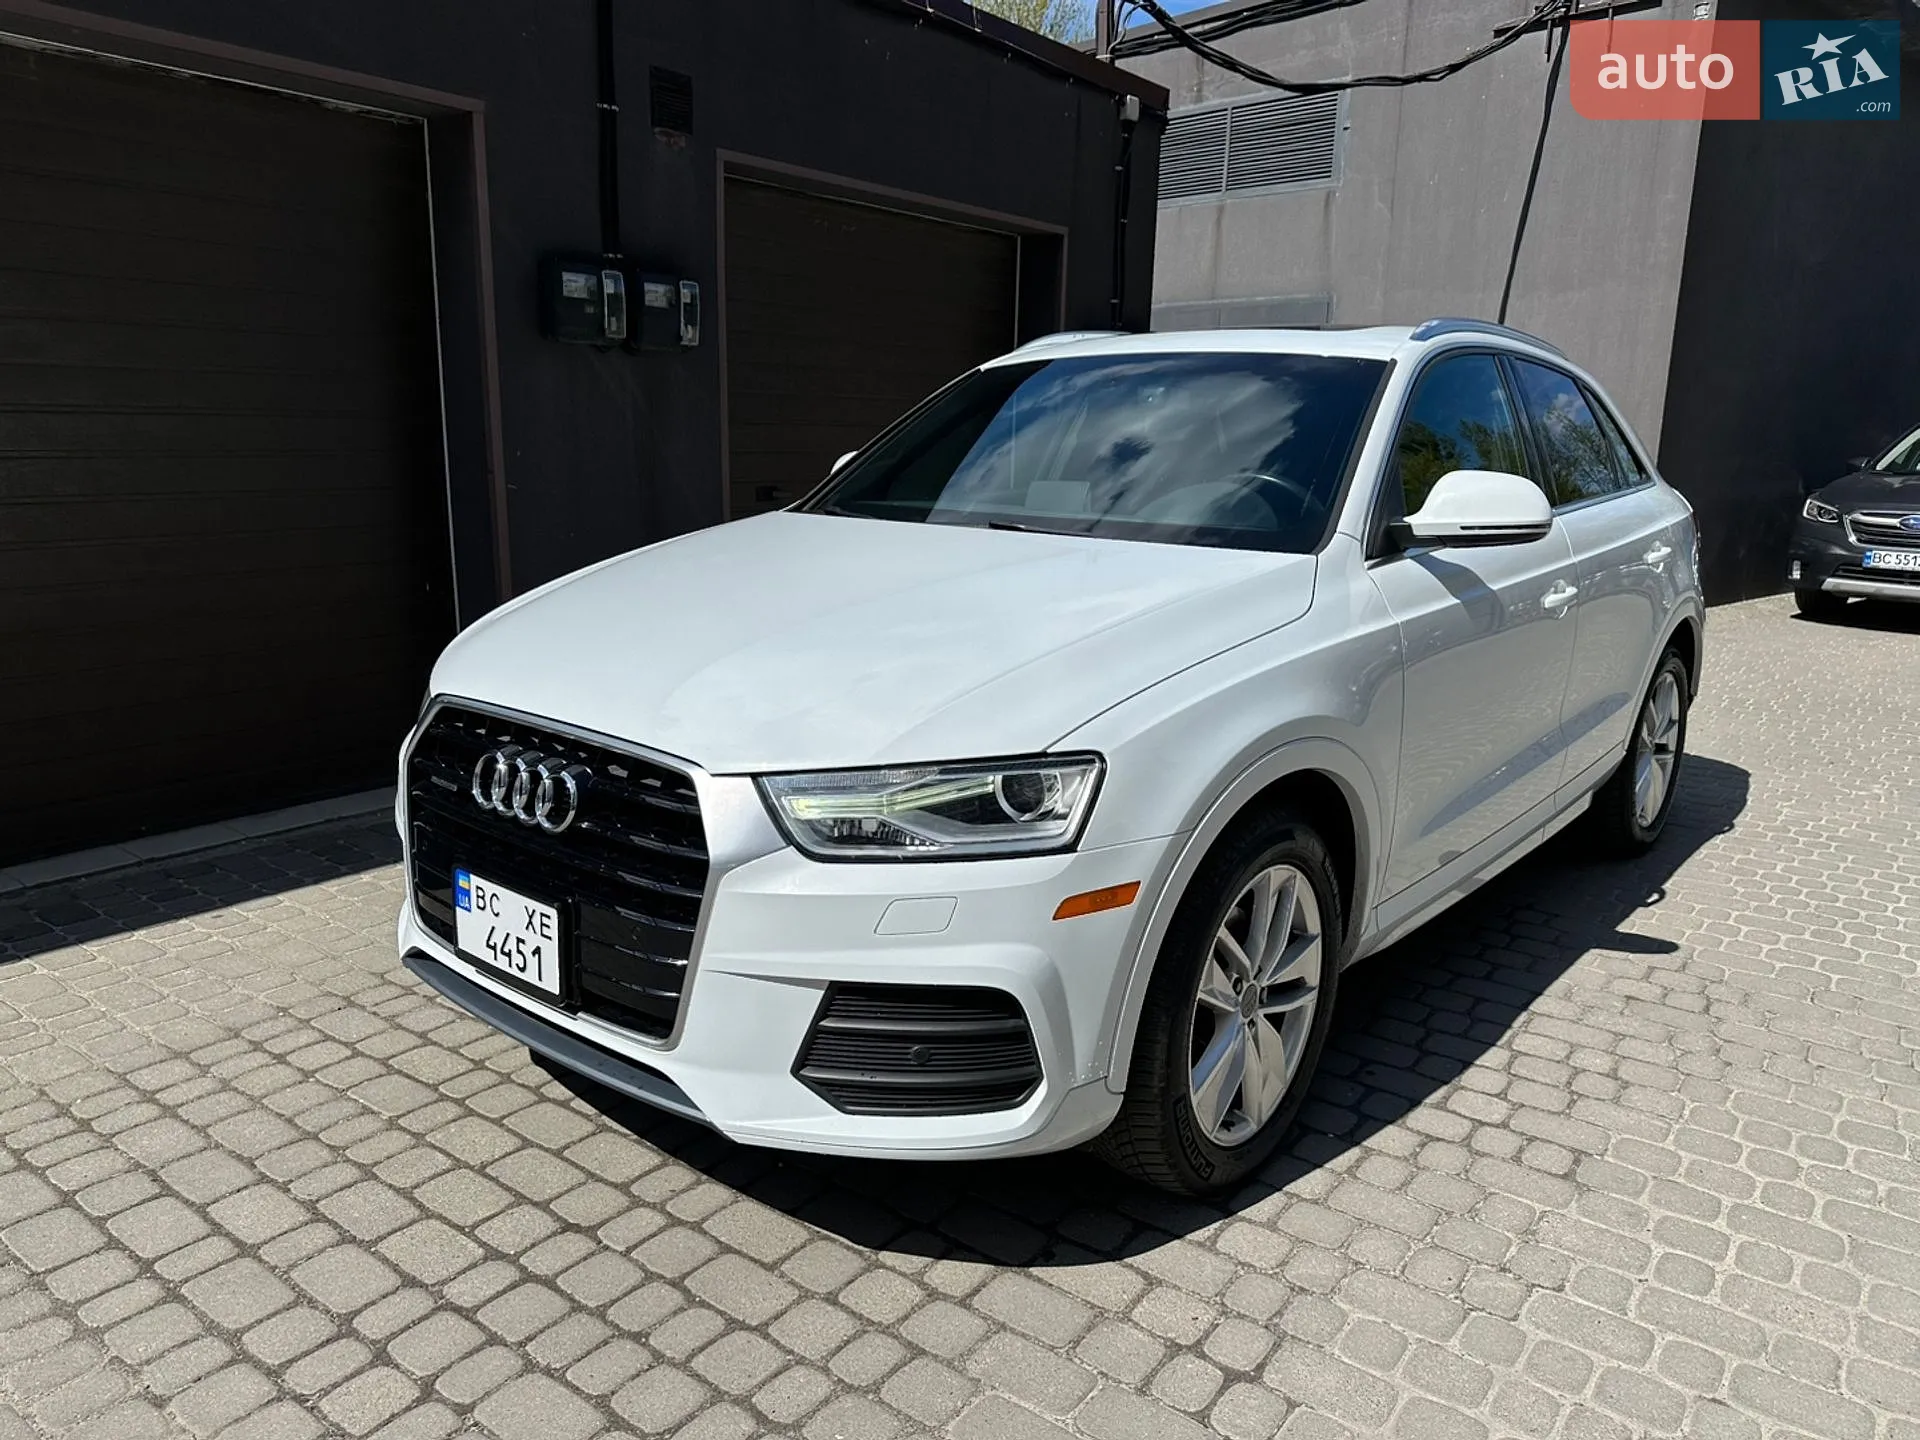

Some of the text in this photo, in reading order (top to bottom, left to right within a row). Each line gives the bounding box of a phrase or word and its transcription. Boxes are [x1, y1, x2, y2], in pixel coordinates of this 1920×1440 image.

[1872, 552, 1892, 565] BC
[458, 895, 471, 910] UA
[475, 885, 552, 941] BC XE
[486, 926, 543, 982] 4451
